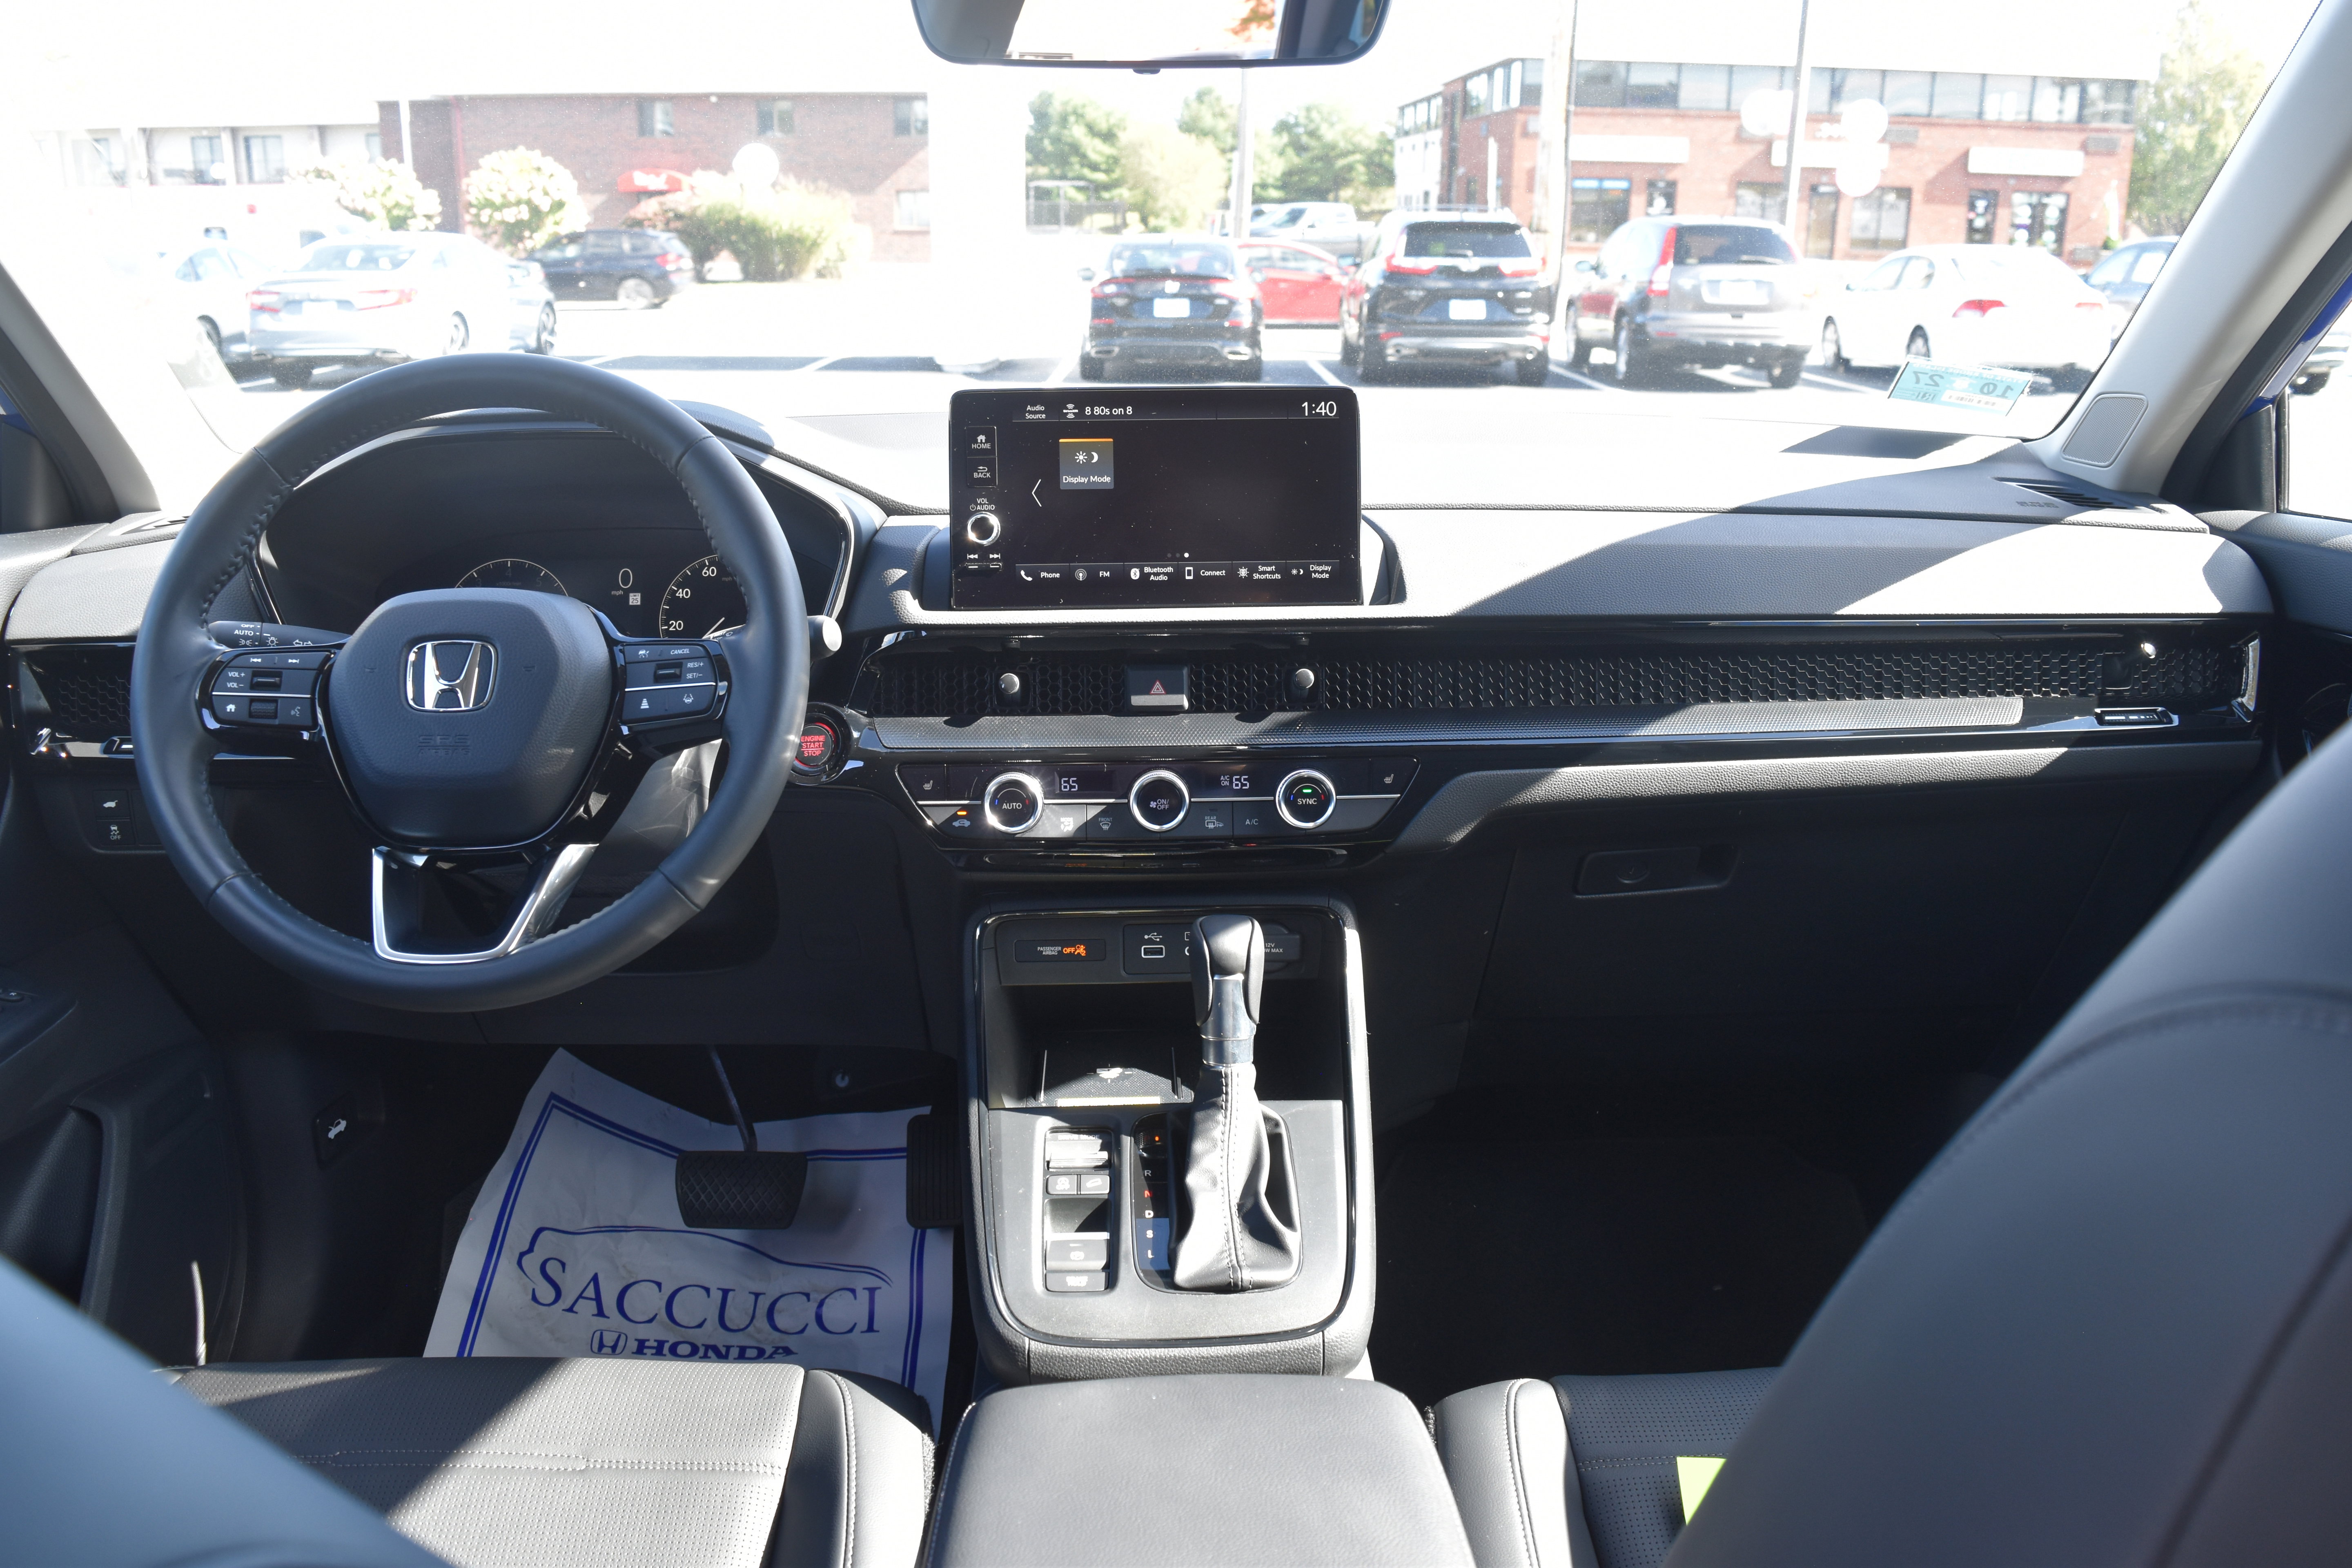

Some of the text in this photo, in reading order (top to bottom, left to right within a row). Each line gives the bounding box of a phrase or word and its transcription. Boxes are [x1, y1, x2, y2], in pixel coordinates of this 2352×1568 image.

[1085, 407, 1091, 415] 8
[1094, 406, 1110, 415] 80s
[1126, 406, 1133, 414] 8
[1302, 401, 1336, 416] 1:40
[1062, 475, 1089, 483] Display
[702, 567, 717, 577] 60
[619, 568, 633, 588] 0
[676, 588, 690, 599] 40
[669, 621, 684, 631] 20
[419, 735, 470, 744] SRS
[1061, 778, 1078, 791] 65
[1233, 776, 1250, 789] 65
[1148, 1250, 1154, 1258] L
[531, 1257, 882, 1335] SACCUCCI
[632, 1338, 799, 1360] HONDA
